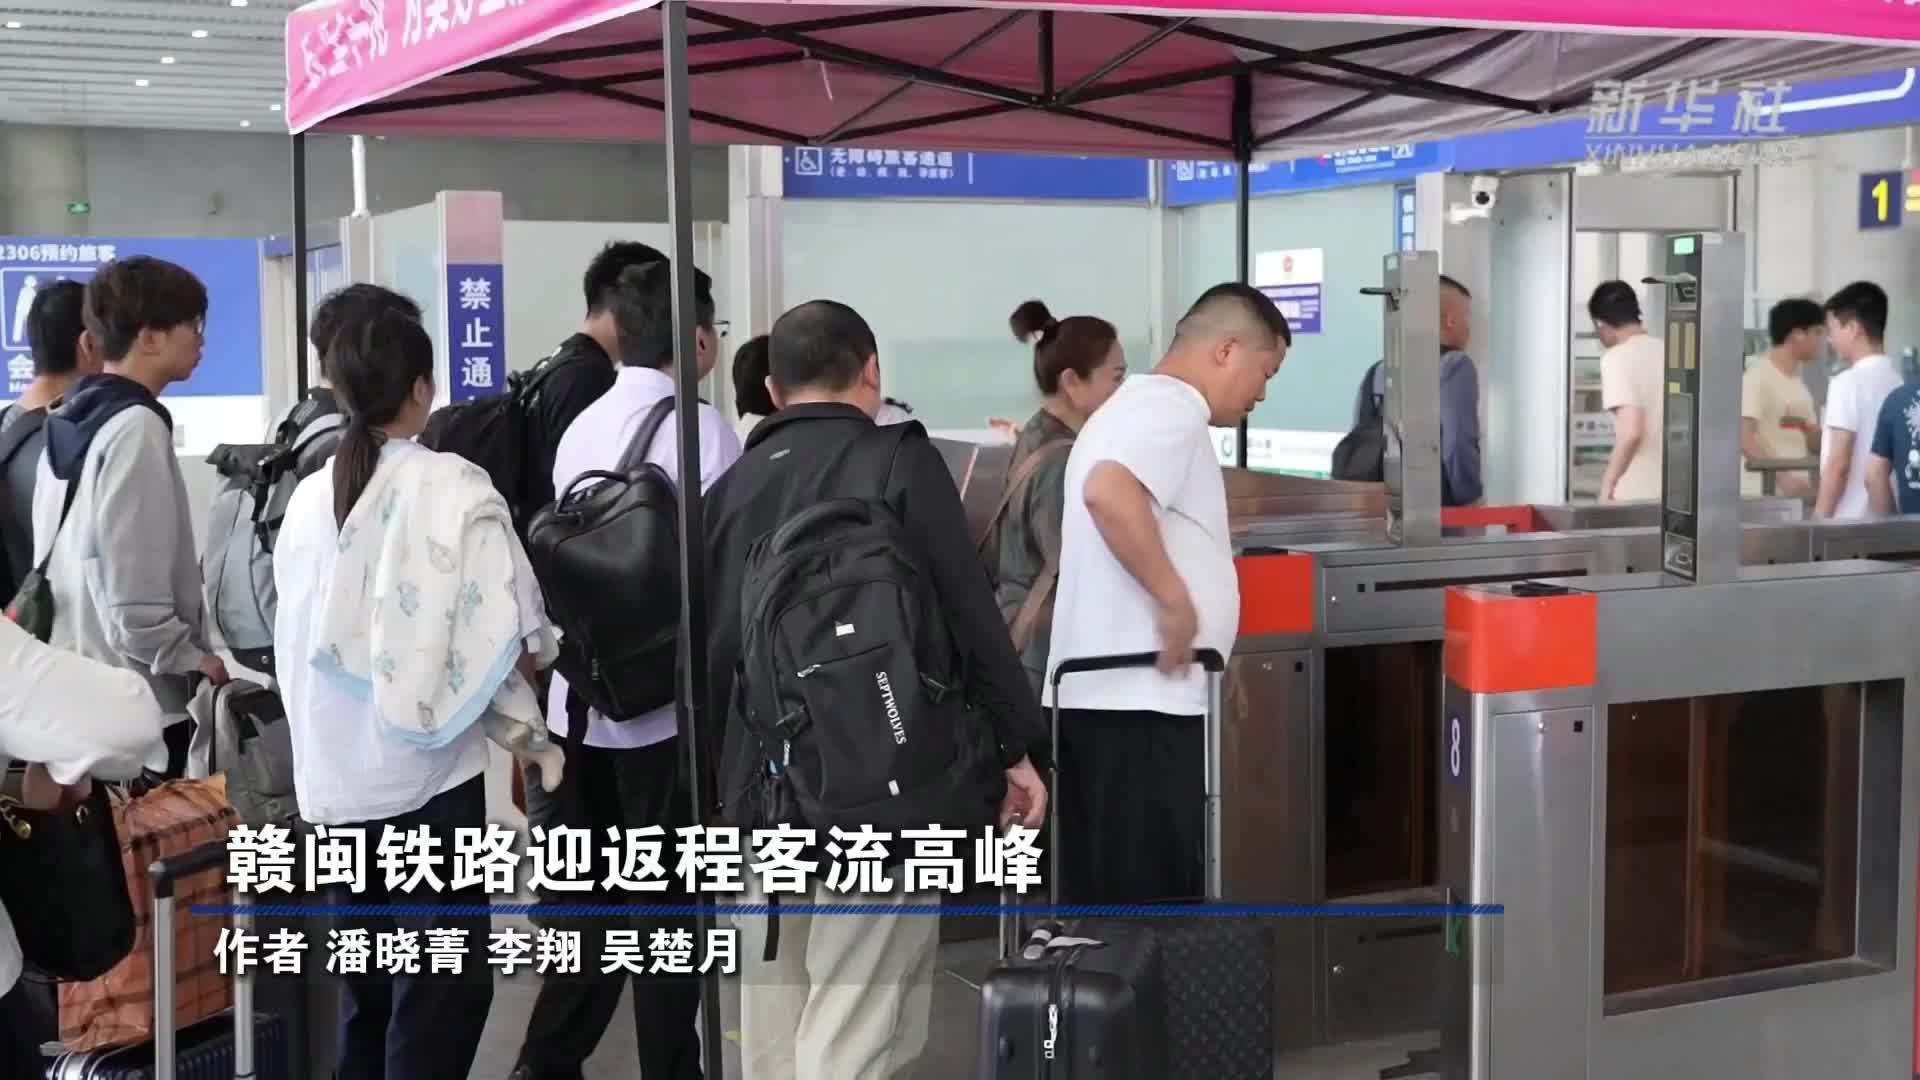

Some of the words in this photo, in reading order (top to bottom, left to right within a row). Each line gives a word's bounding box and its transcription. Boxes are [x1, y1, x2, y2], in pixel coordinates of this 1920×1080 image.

[1871, 178, 1889, 221] 1
[459, 277, 493, 401] 禁止通
[875, 671, 907, 745] SEPTWOLVES
[1450, 717, 1461, 777] 8
